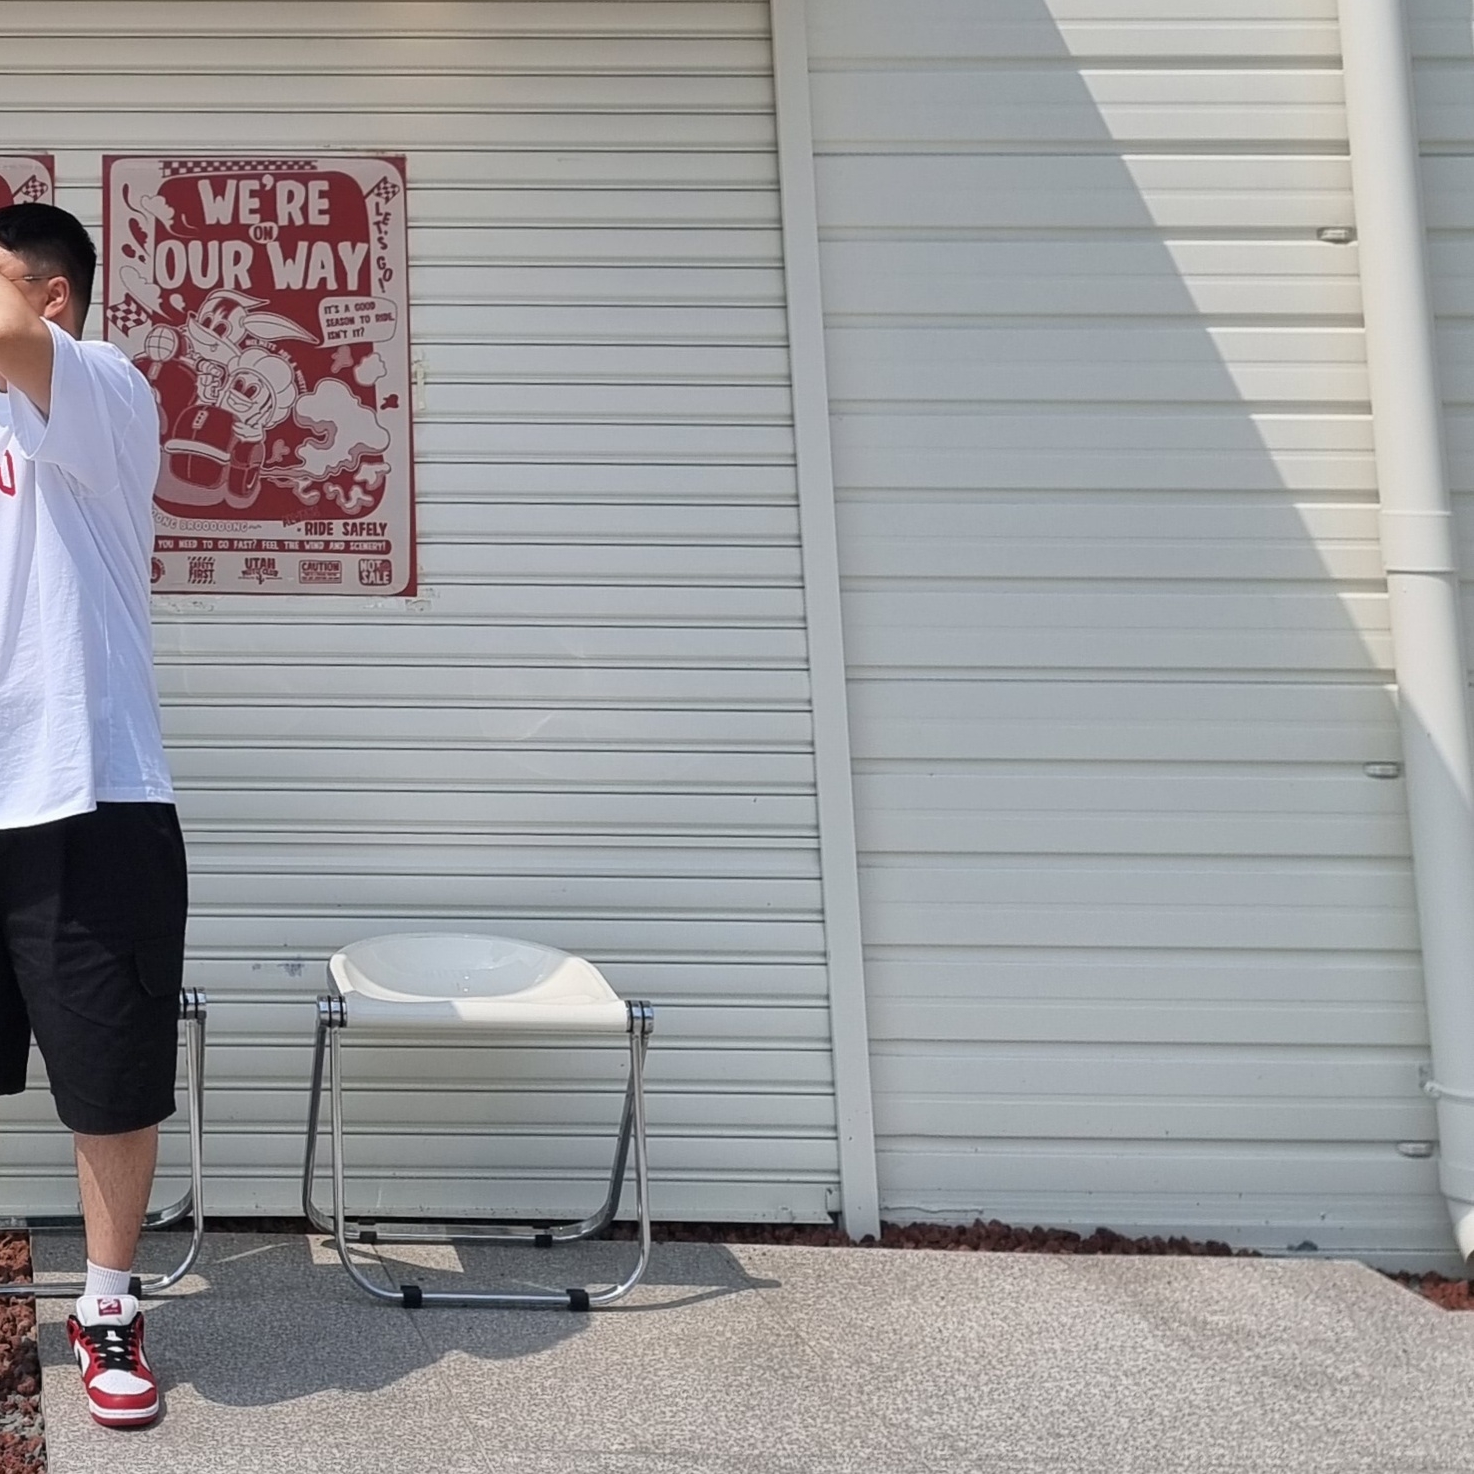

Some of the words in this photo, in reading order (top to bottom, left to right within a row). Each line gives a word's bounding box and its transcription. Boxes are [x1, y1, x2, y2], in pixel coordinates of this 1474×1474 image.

[198, 174, 330, 226] WE'RE
[253, 226, 274, 241] ON
[155, 239, 254, 290] OUR
[266, 240, 369, 291] WAY
[344, 304, 351, 313] A
[354, 301, 376, 312] GOOD
[326, 316, 355, 327] SEASON
[359, 314, 371, 324] TO
[353, 327, 365, 338] IT?
[305, 521, 334, 536] RIDE
[342, 521, 387, 536] SAFELY
[157, 539, 174, 548] YOU
[179, 540, 198, 548] NEED
[202, 540, 213, 549] TO
[218, 540, 229, 549] GO
[233, 539, 257, 549] FAST?
[262, 541, 279, 550] FEEL
[284, 541, 299, 550] THE
[304, 541, 324, 550] WIND
[329, 541, 345, 550] AND
[350, 541, 386, 551] SCENERY!
[245, 557, 276, 568] UTAH
[301, 562, 339, 571] CAUTION
[360, 560, 383, 571] NOT
[189, 569, 215, 579] FIRST
[362, 571, 389, 584] SALE
